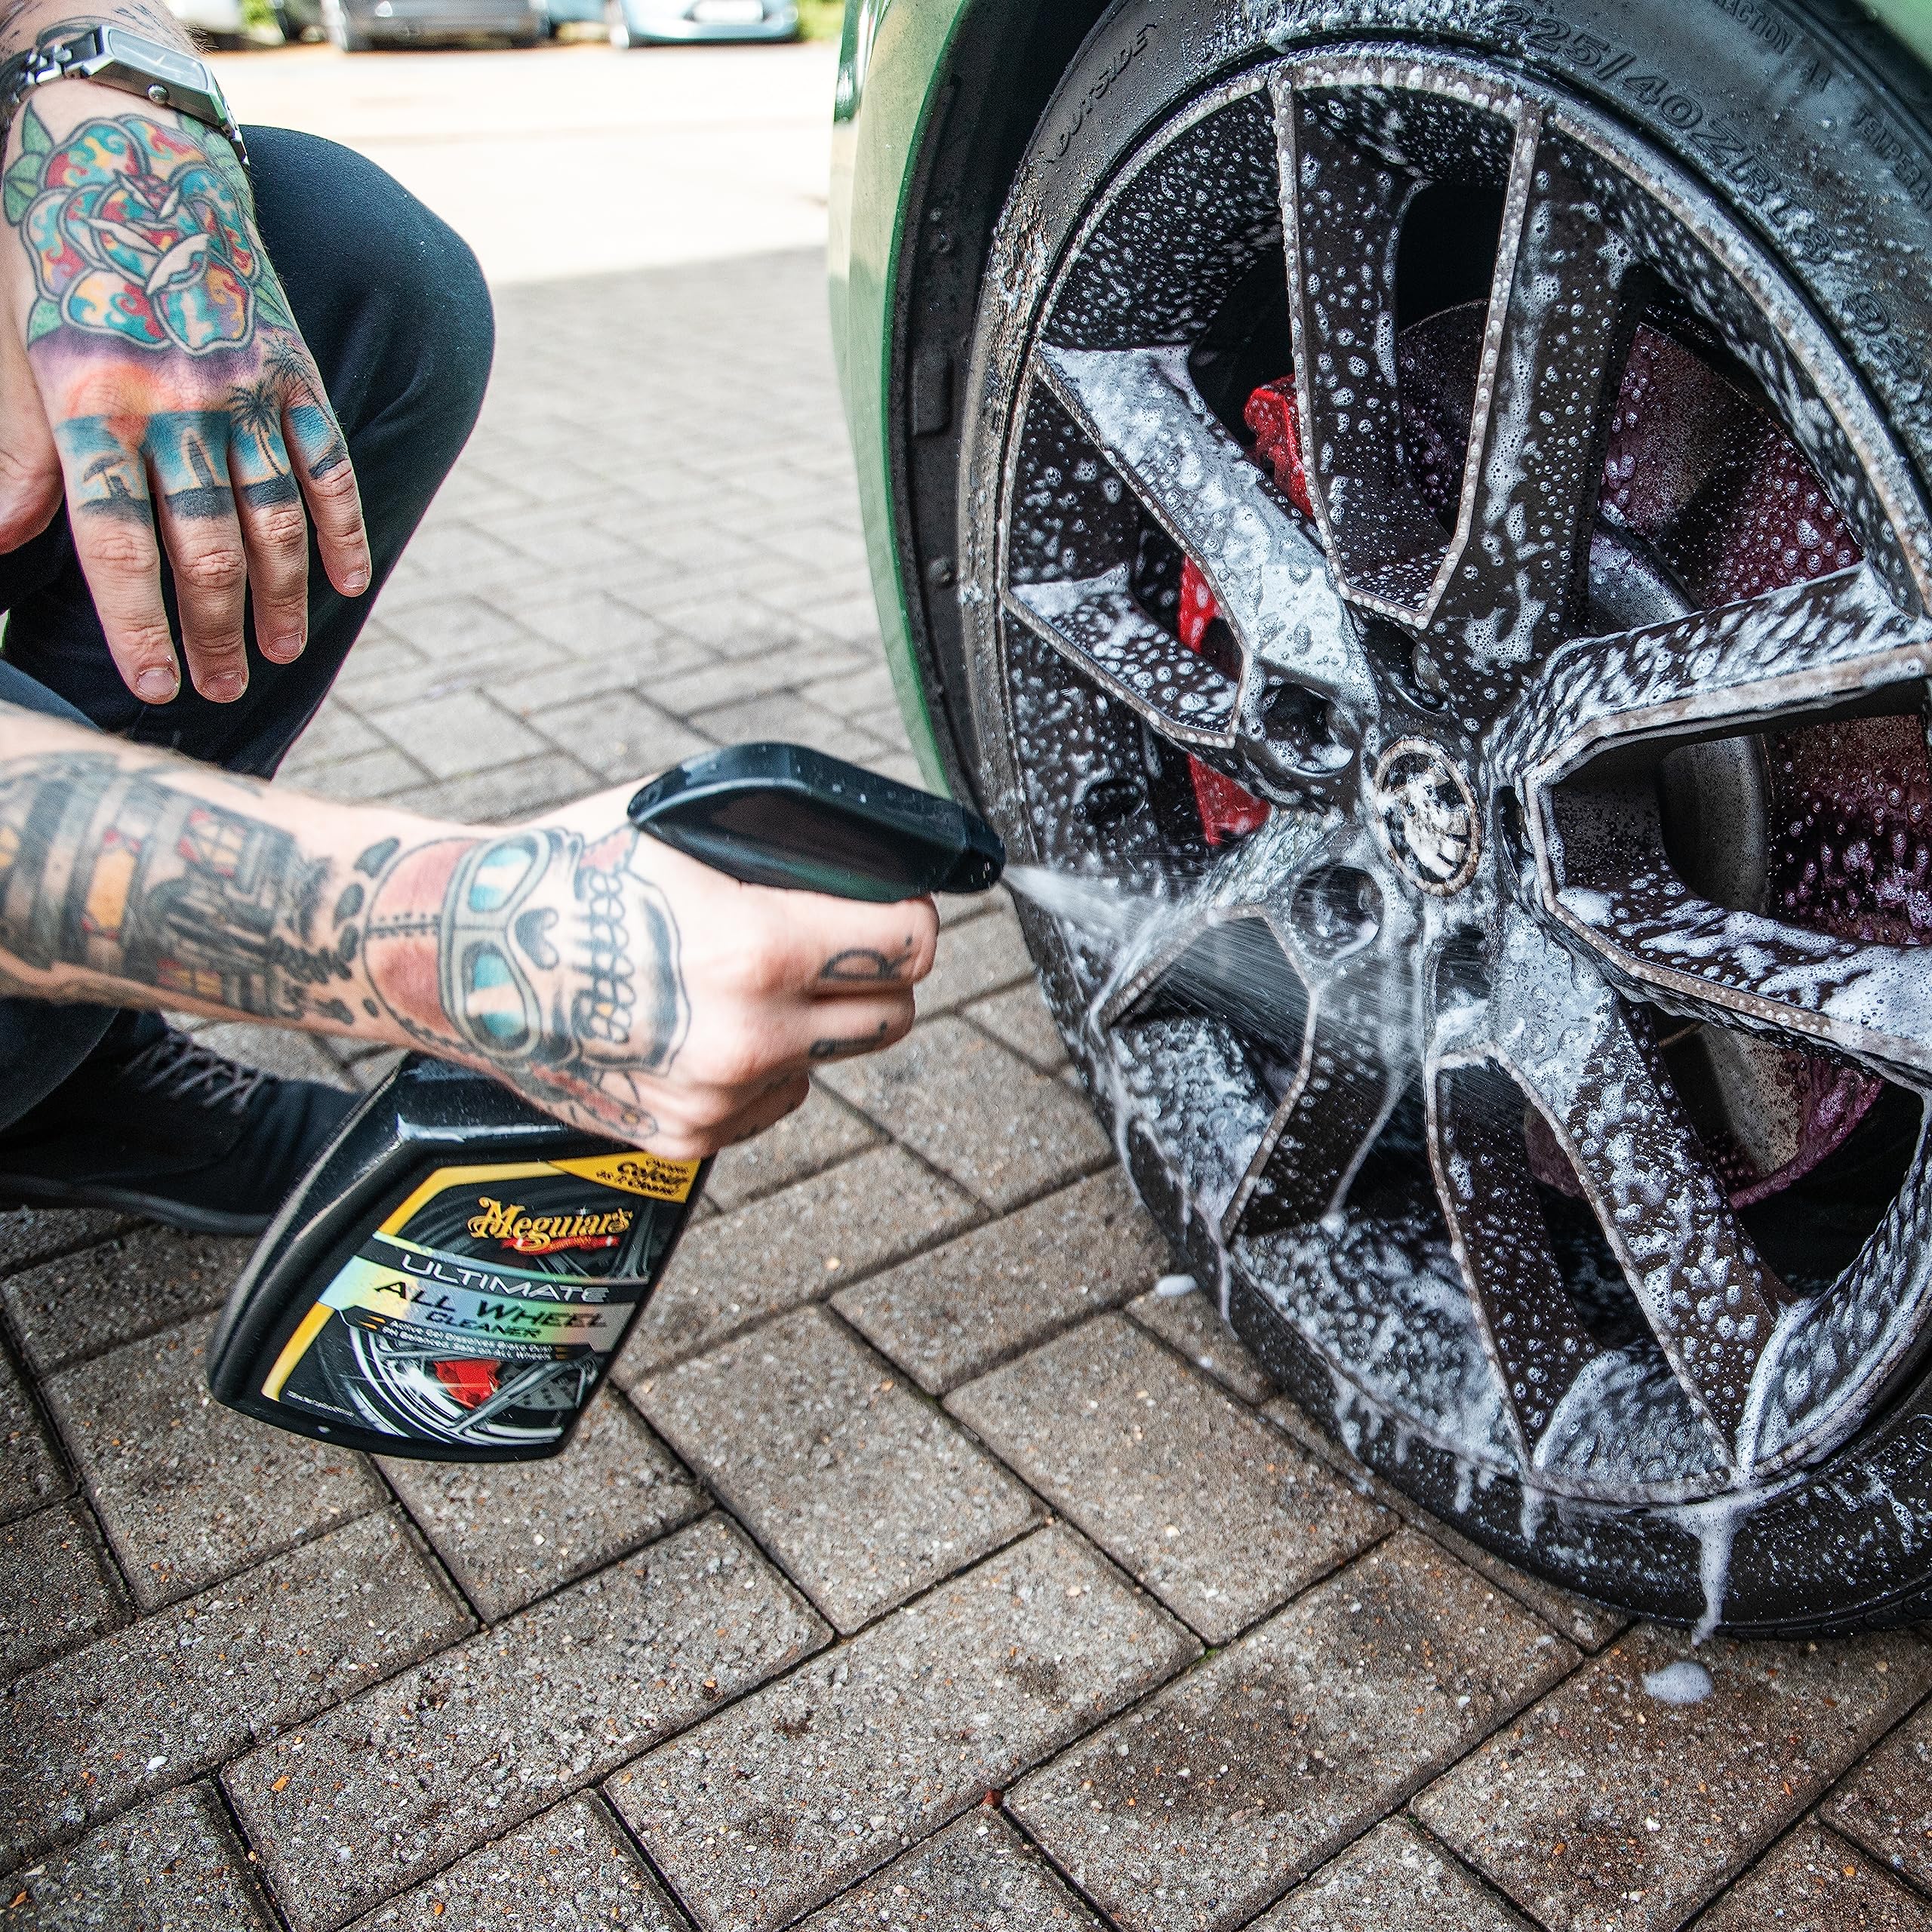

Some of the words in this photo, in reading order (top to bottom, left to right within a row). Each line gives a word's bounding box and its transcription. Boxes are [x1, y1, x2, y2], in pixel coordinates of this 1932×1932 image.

[1715, 0, 1792, 55] ACTION
[401, 1254, 609, 1303] ULTIMATE
[374, 1281, 456, 1312] ALL
[476, 1300, 607, 1328] WHEEL
[426, 1310, 543, 1339] CLEANER
